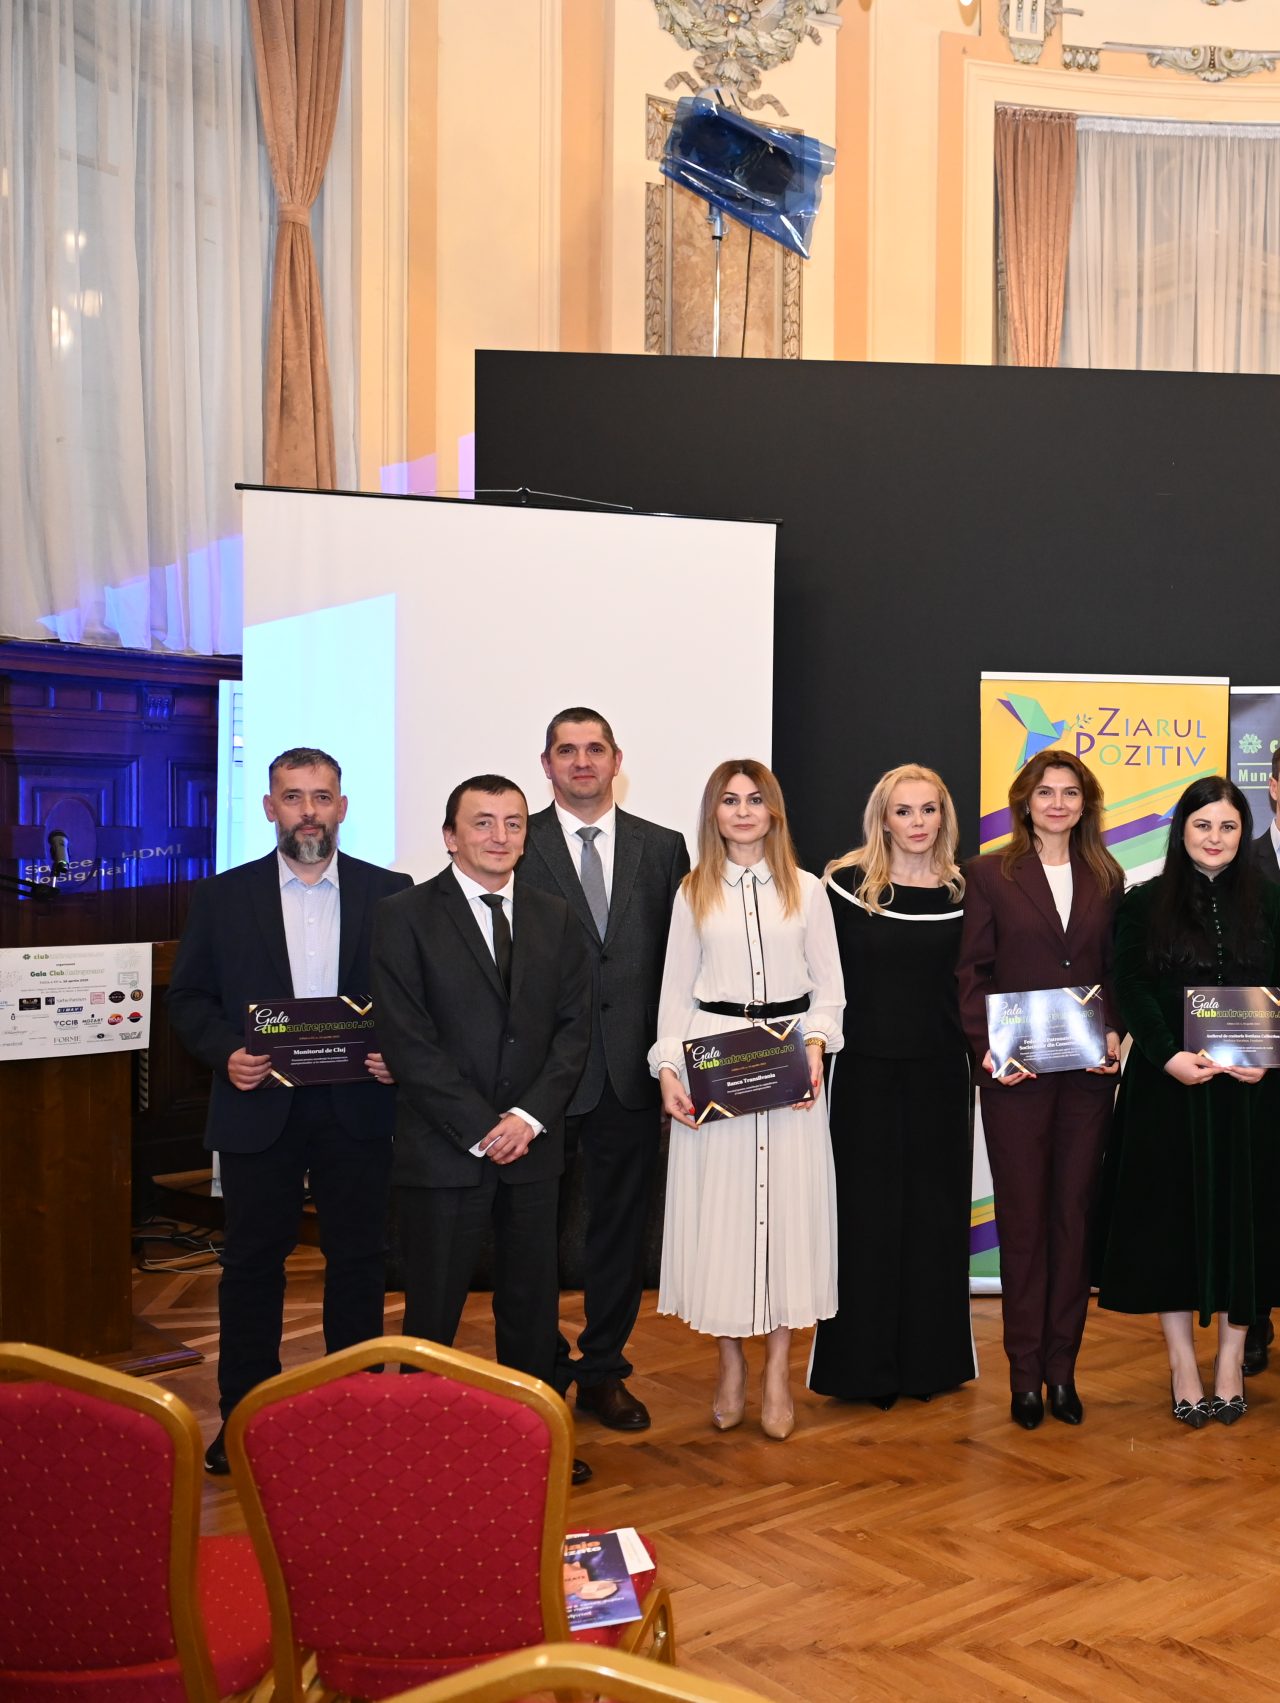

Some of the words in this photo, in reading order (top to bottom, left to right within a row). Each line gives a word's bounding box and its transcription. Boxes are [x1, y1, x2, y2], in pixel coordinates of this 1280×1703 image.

[1097, 707, 1207, 739] ZIARUL
[1076, 732, 1206, 767] POZITIV
[122, 844, 181, 859] HDMI
[1191, 994, 1220, 1015] Gala
[254, 1009, 290, 1031] Gala
[692, 1046, 721, 1069] Gala
